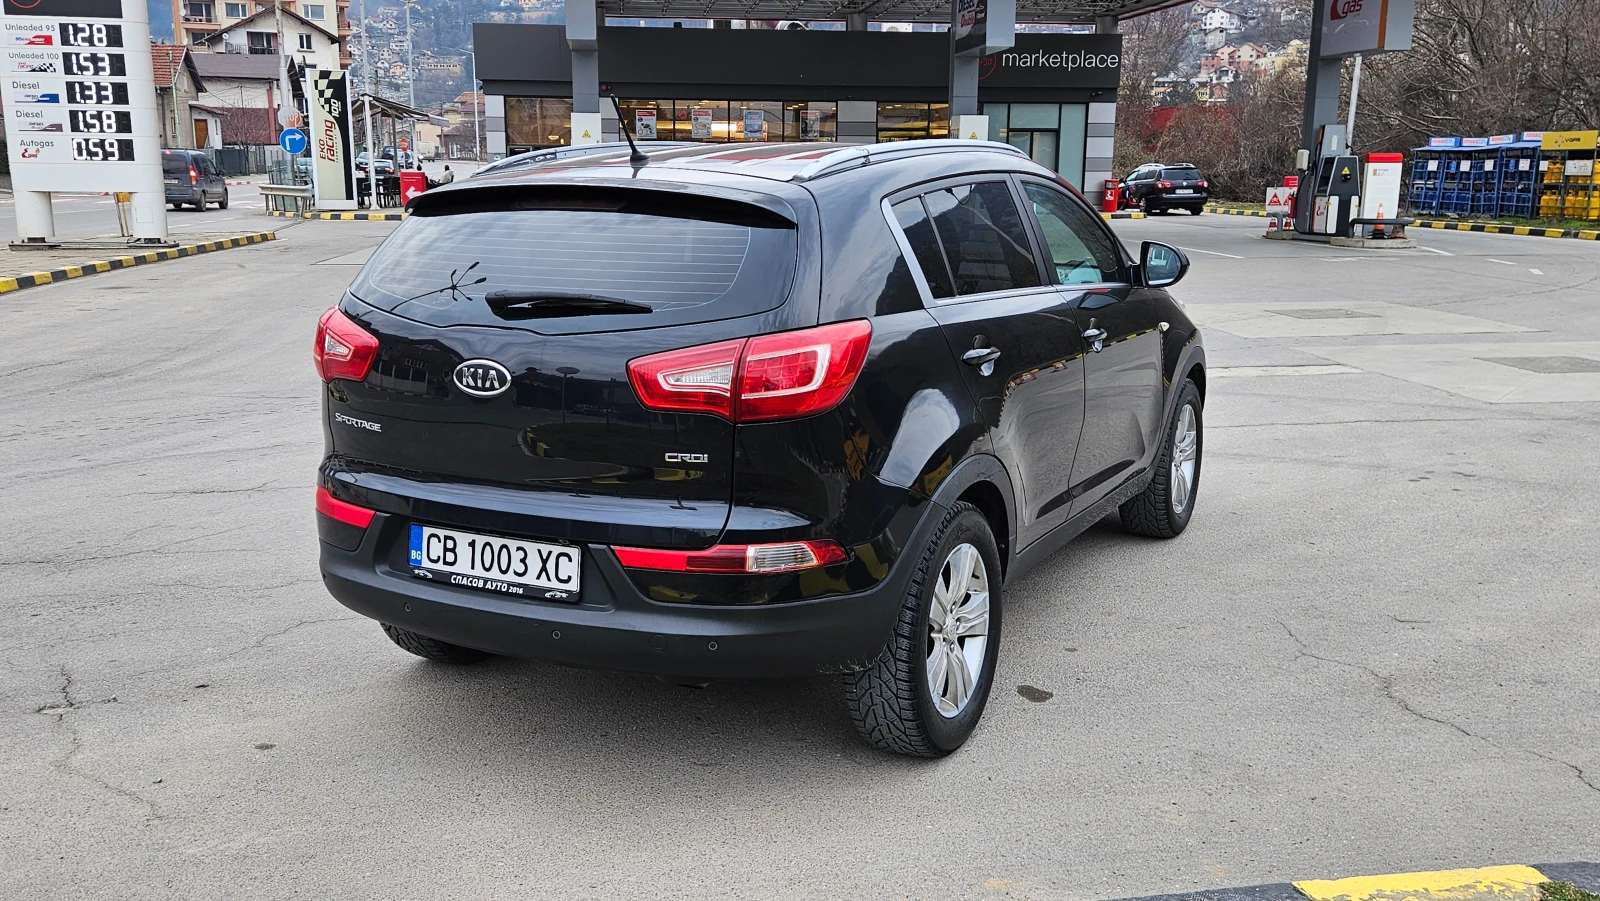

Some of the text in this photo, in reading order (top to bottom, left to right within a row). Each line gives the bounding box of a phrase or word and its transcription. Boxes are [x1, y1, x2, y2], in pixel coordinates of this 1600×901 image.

[5, 23, 56, 32] Unleaded 95
[1002, 49, 1119, 71] marketplace
[12, 81, 40, 90] Diesel
[15, 110, 43, 118] Diesel
[330, 98, 340, 118] 100
[20, 139, 55, 149] Autogas
[72, 138, 120, 160] 0.59
[318, 138, 326, 160] EKO
[324, 119, 336, 162] racing
[461, 366, 500, 389] KIA
[335, 412, 382, 433] SPORTAGE
[411, 549, 422, 560] BG
[426, 532, 573, 584] CB 1003 XC
[450, 574, 524, 595] СПАСОВ АУТО 2016
